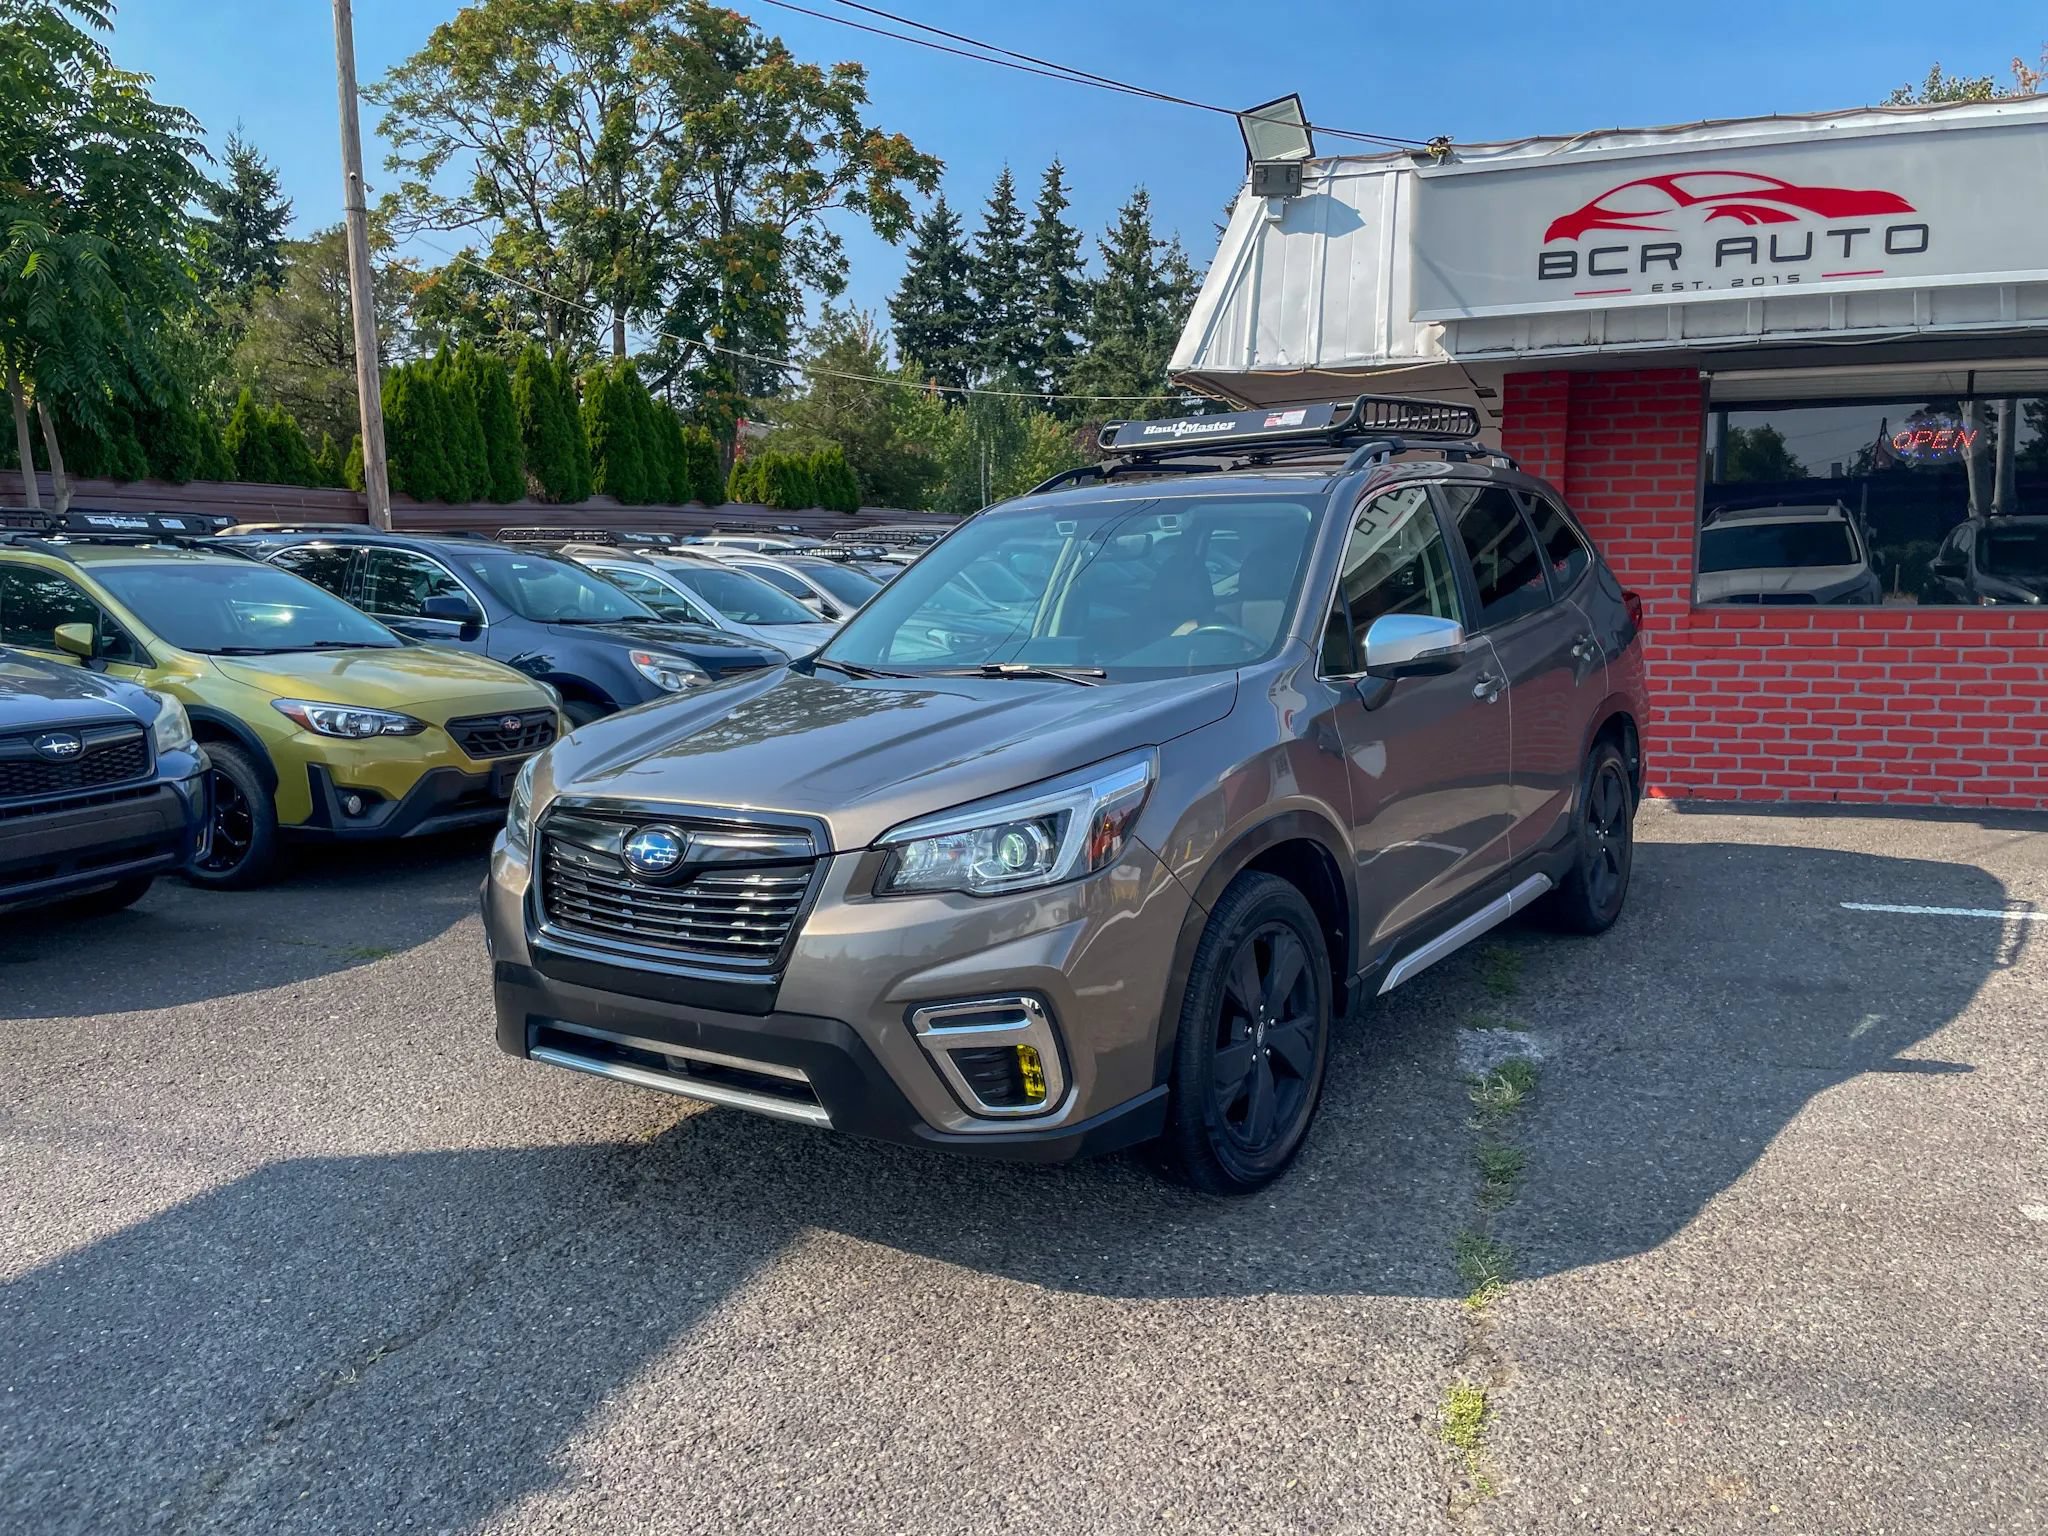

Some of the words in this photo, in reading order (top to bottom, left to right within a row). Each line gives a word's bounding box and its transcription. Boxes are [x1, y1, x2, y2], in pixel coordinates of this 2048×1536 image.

[1538, 242, 1683, 281] BCR
[1715, 223, 1930, 268] AUTO
[1651, 281, 1713, 293] EST.
[1730, 273, 1801, 288] 2015
[1892, 429, 1978, 450] OPEN
